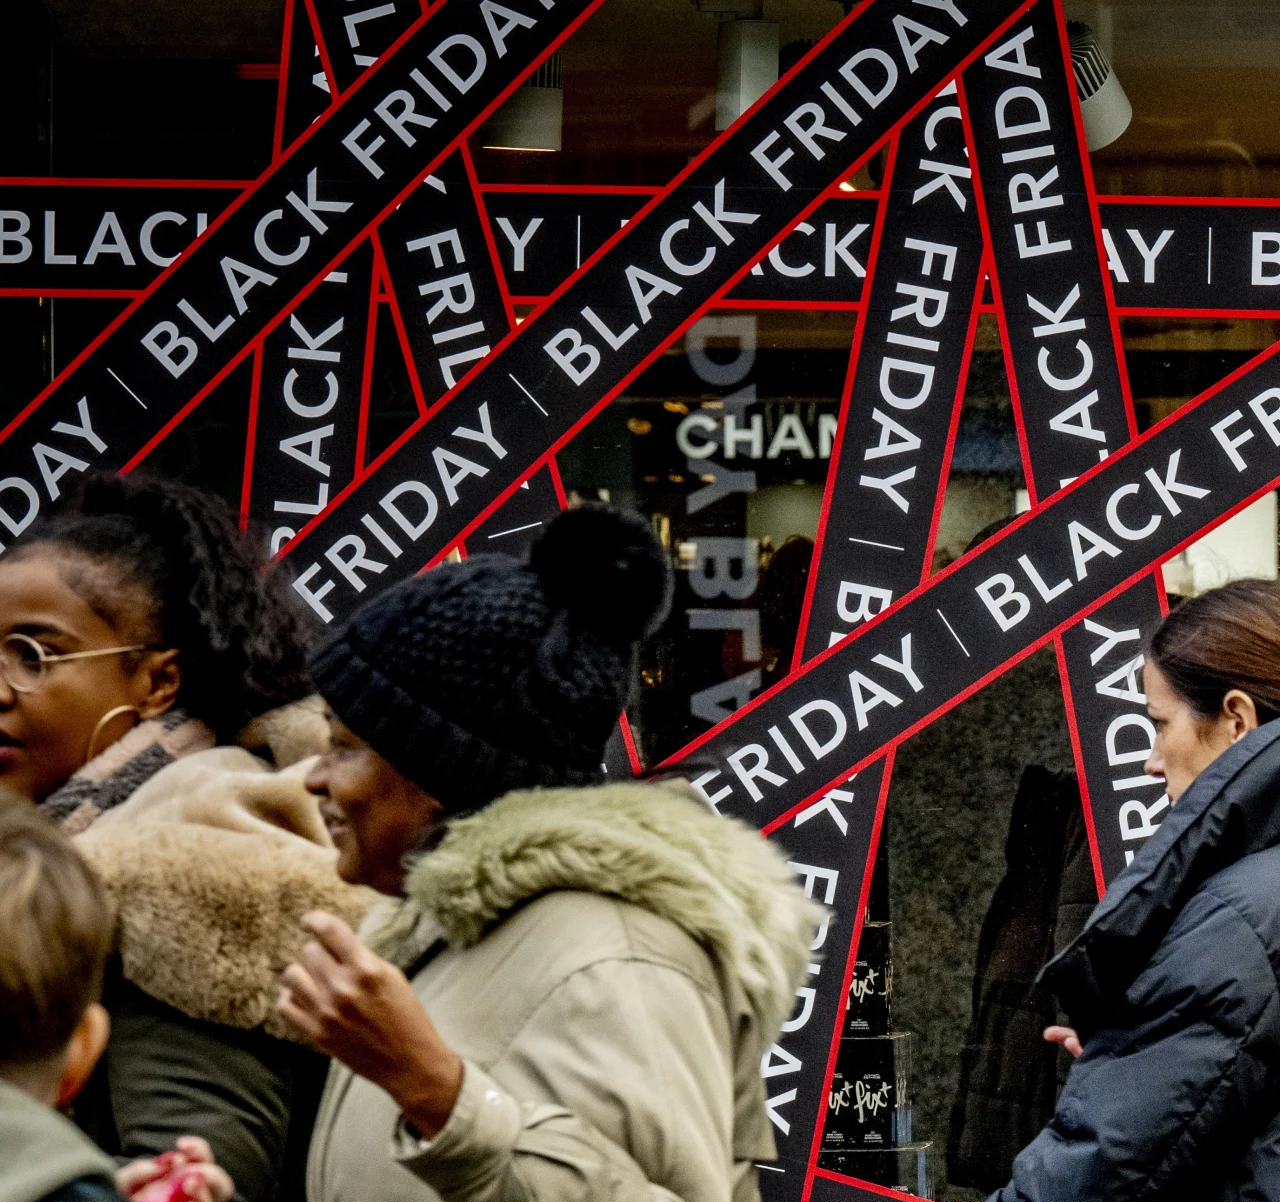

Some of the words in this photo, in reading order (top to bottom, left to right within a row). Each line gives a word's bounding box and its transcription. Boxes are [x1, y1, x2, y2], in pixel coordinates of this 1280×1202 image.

[0, 211, 208, 267] BLAC
[0, 397, 106, 549] DAY
[142, 170, 350, 376] BLACK
[343, 0, 553, 177] FRIDA
[984, 26, 1072, 259] FRIDA
[293, 404, 506, 621] FRIDAY
[545, 180, 757, 384] BLACK
[858, 237, 958, 515] FRIDAY
[1026, 283, 1109, 490] ACK
[689, 636, 922, 816] FRIDAY
[976, 450, 1209, 631] BLACK
[1084, 617, 1172, 868] RIDAY
